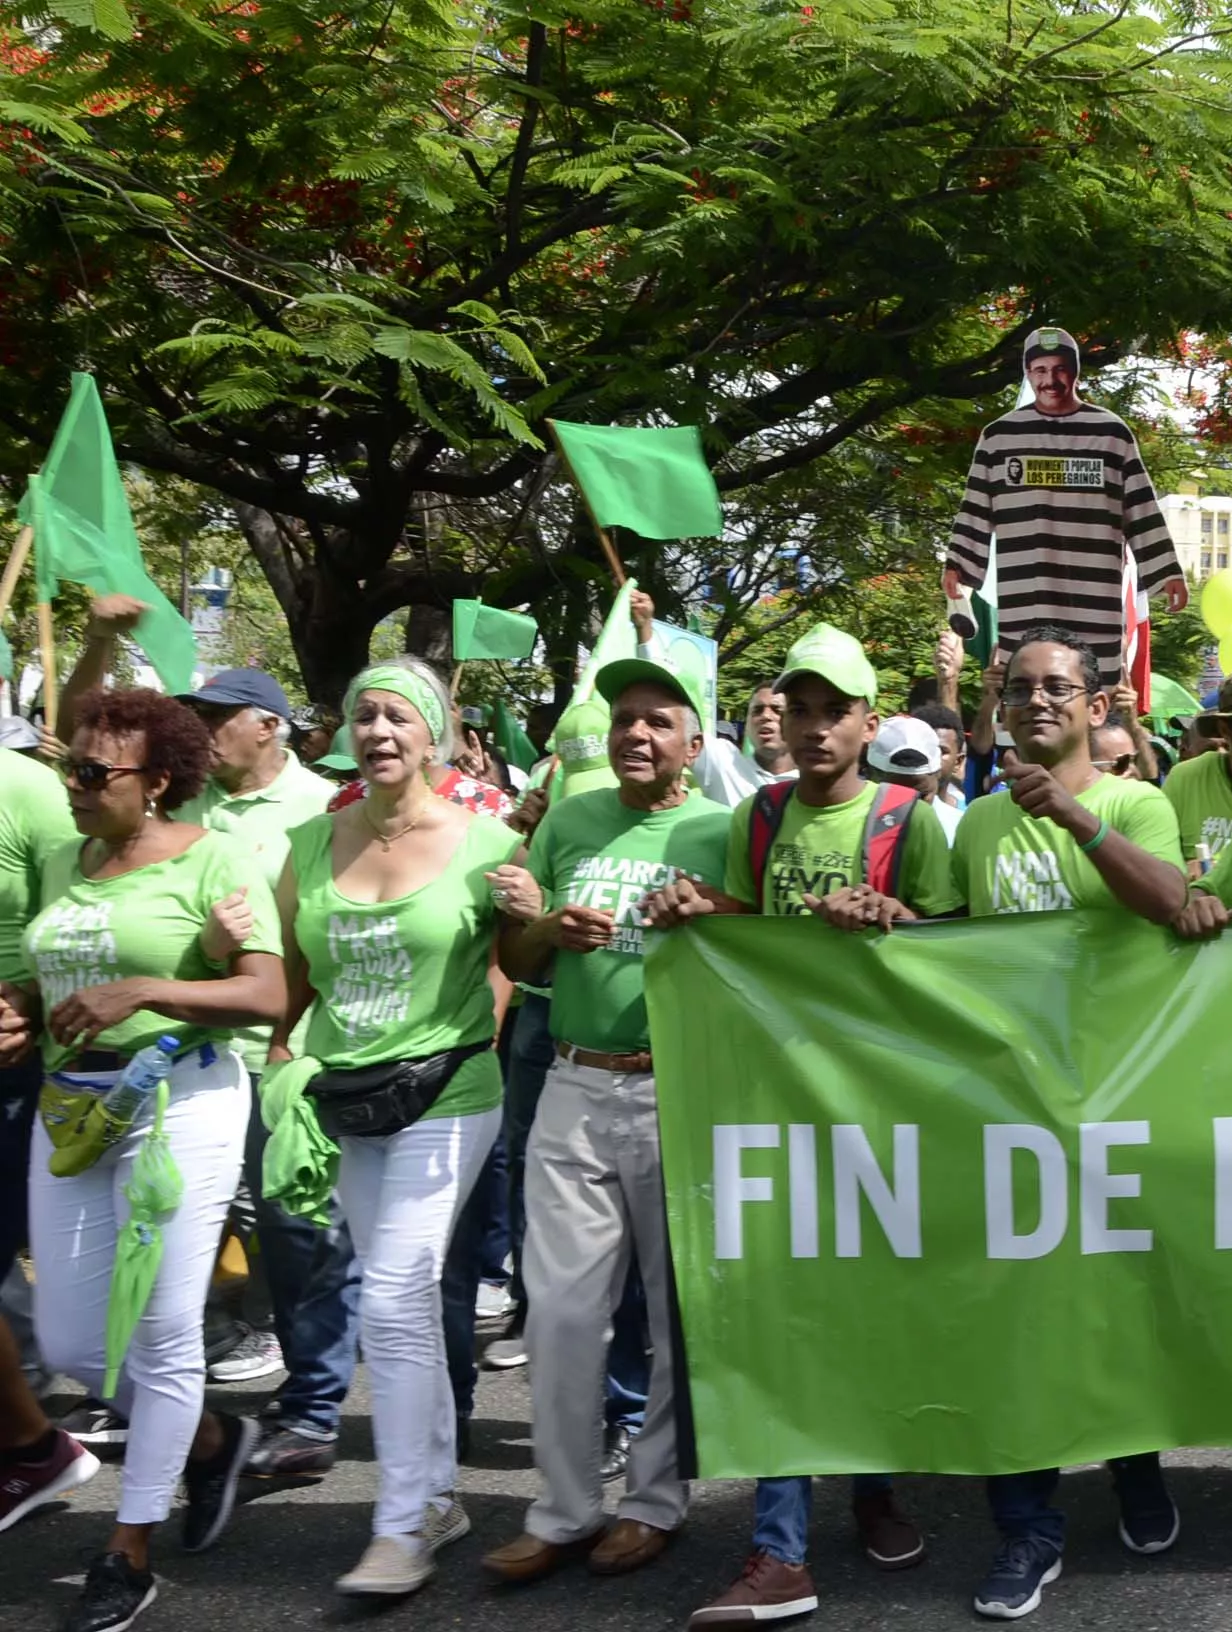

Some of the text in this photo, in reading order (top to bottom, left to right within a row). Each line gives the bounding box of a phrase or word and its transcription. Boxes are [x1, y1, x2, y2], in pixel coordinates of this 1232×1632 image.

[1027, 471, 1101, 485] LOS PEREGRINOS
[1071, 460, 1101, 472] POPULAR
[993, 850, 1060, 909] MAR
[712, 1123, 922, 1260] FIN
[983, 1120, 1154, 1260] DE
